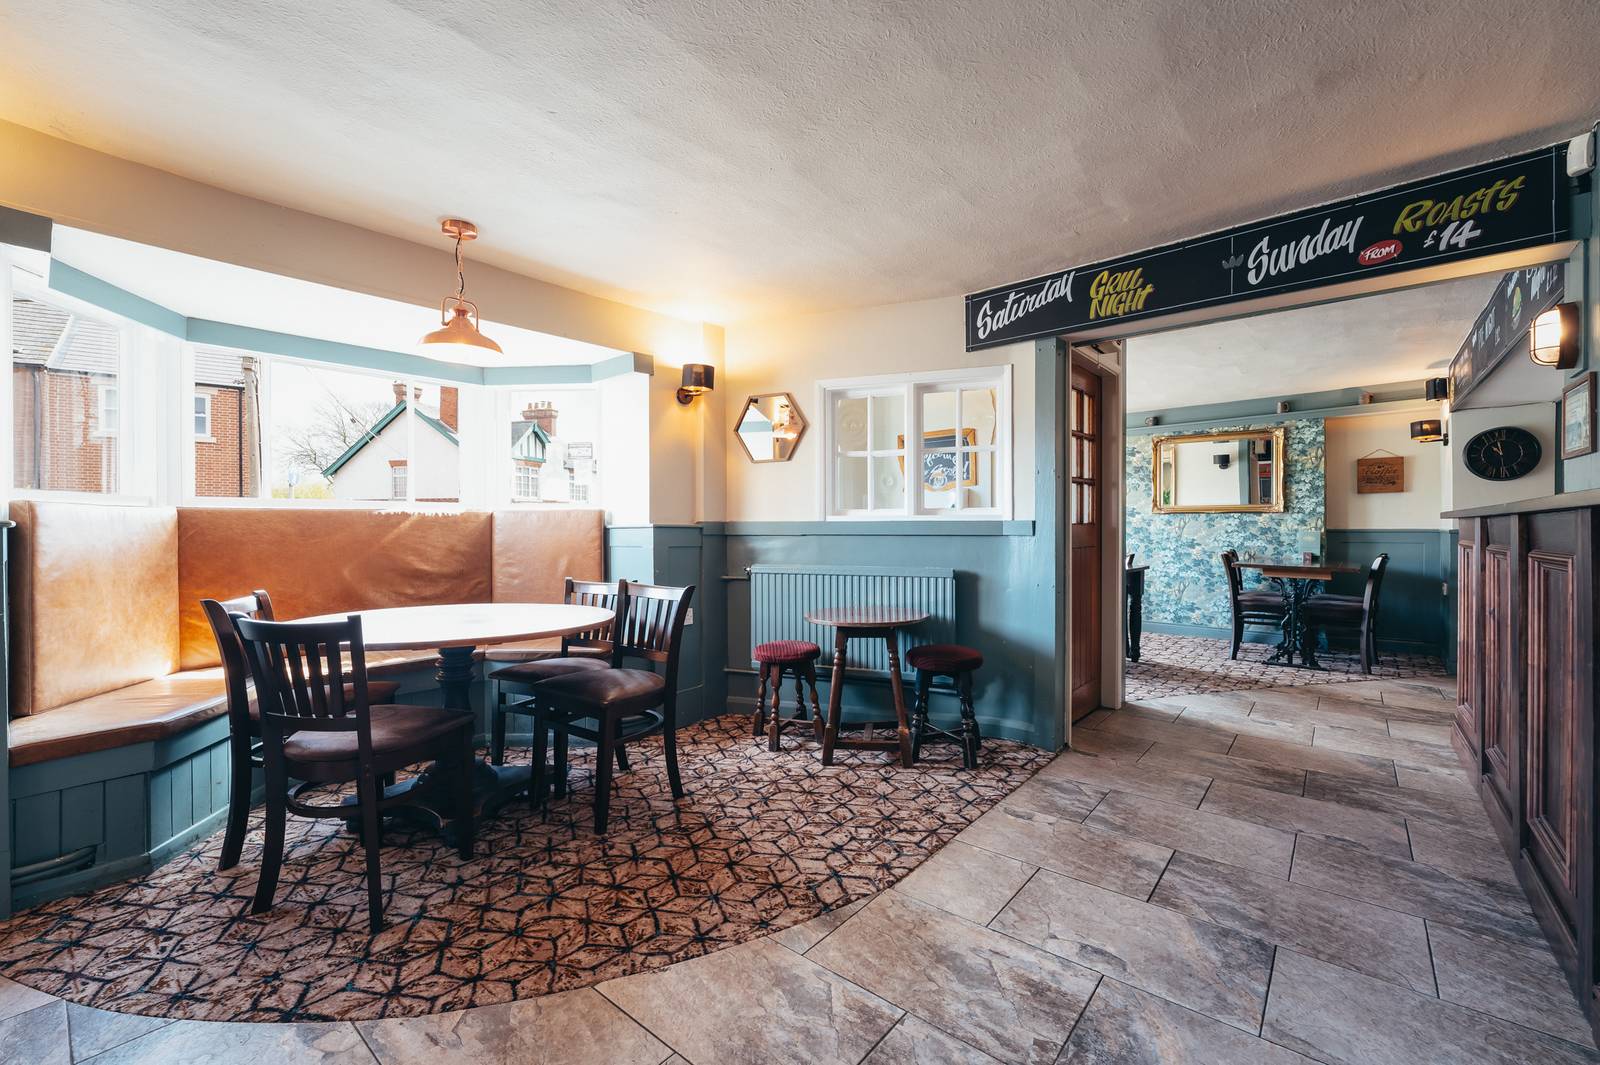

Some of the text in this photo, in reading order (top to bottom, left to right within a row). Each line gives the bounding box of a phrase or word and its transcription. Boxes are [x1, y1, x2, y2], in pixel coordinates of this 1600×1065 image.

[1392, 175, 1527, 235] ROASTS
[1423, 219, 1482, 251] £14
[1247, 216, 1364, 285] Sunday
[1363, 243, 1396, 261] FROM
[976, 270, 1076, 340] Saturday
